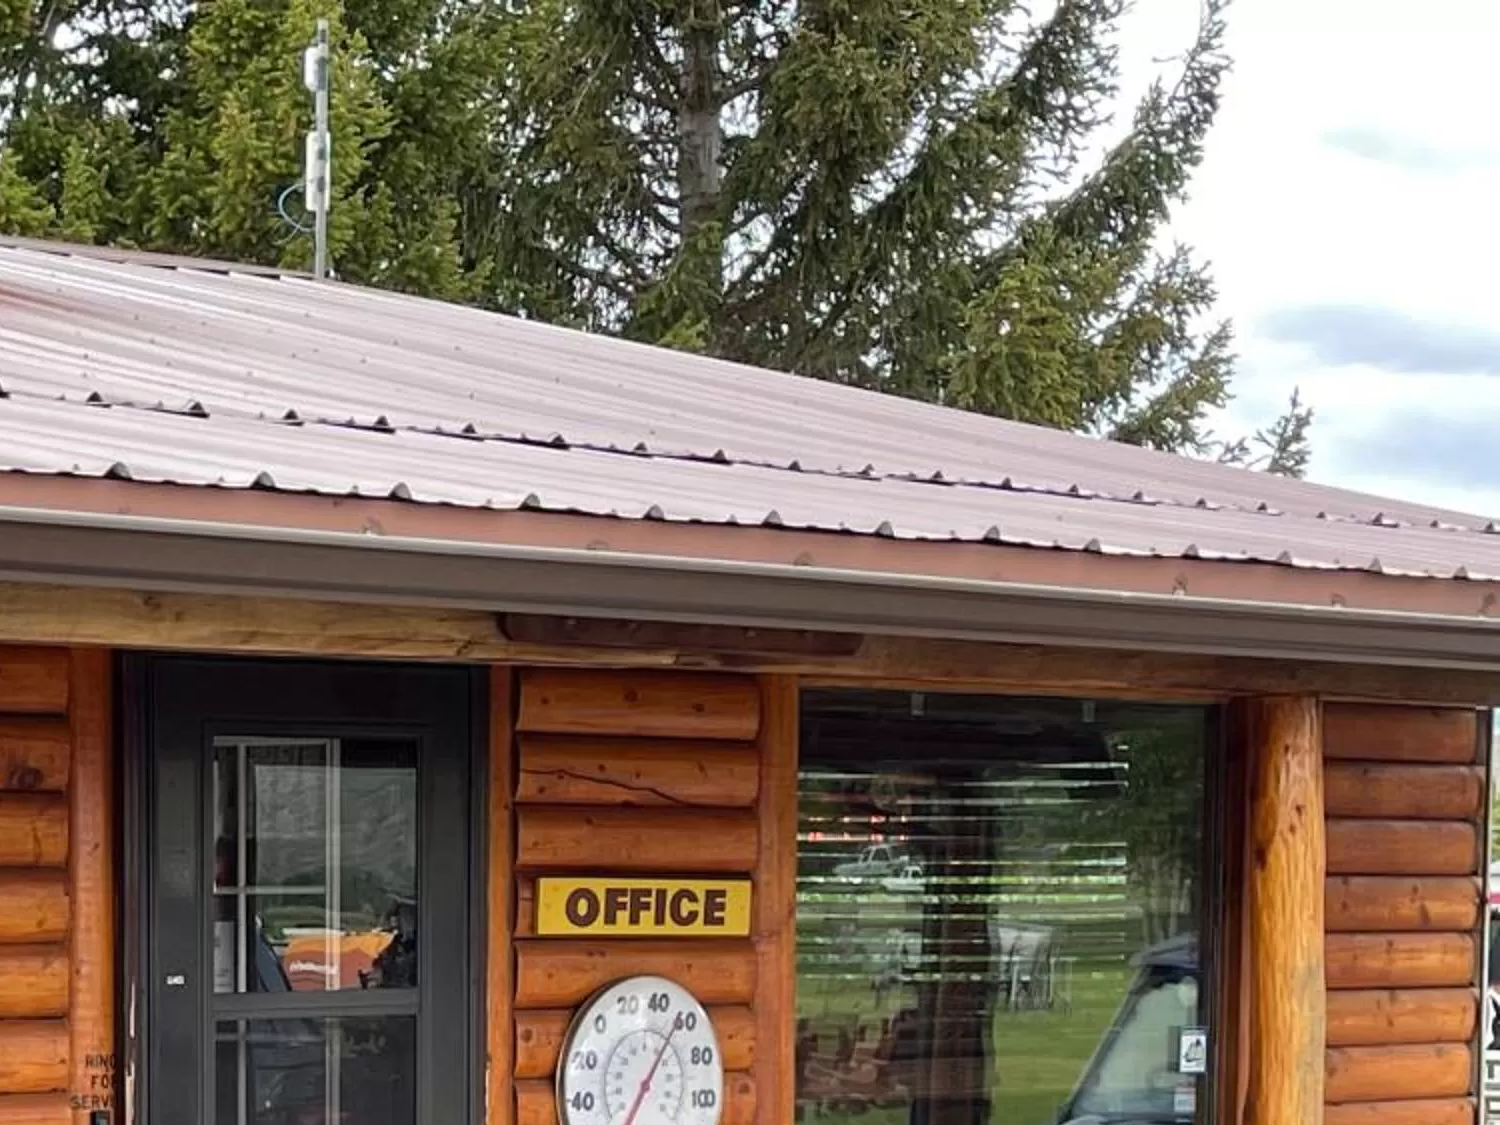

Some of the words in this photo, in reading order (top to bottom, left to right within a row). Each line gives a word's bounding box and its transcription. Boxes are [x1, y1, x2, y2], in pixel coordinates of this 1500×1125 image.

[565, 888, 727, 927] OFFICE
[617, 995, 639, 1014] 20
[648, 993, 670, 1012] 40
[594, 1014, 607, 1034] 0
[675, 1011, 697, 1031] 60
[691, 1046, 713, 1066] 80
[692, 1089, 716, 1108] 100
